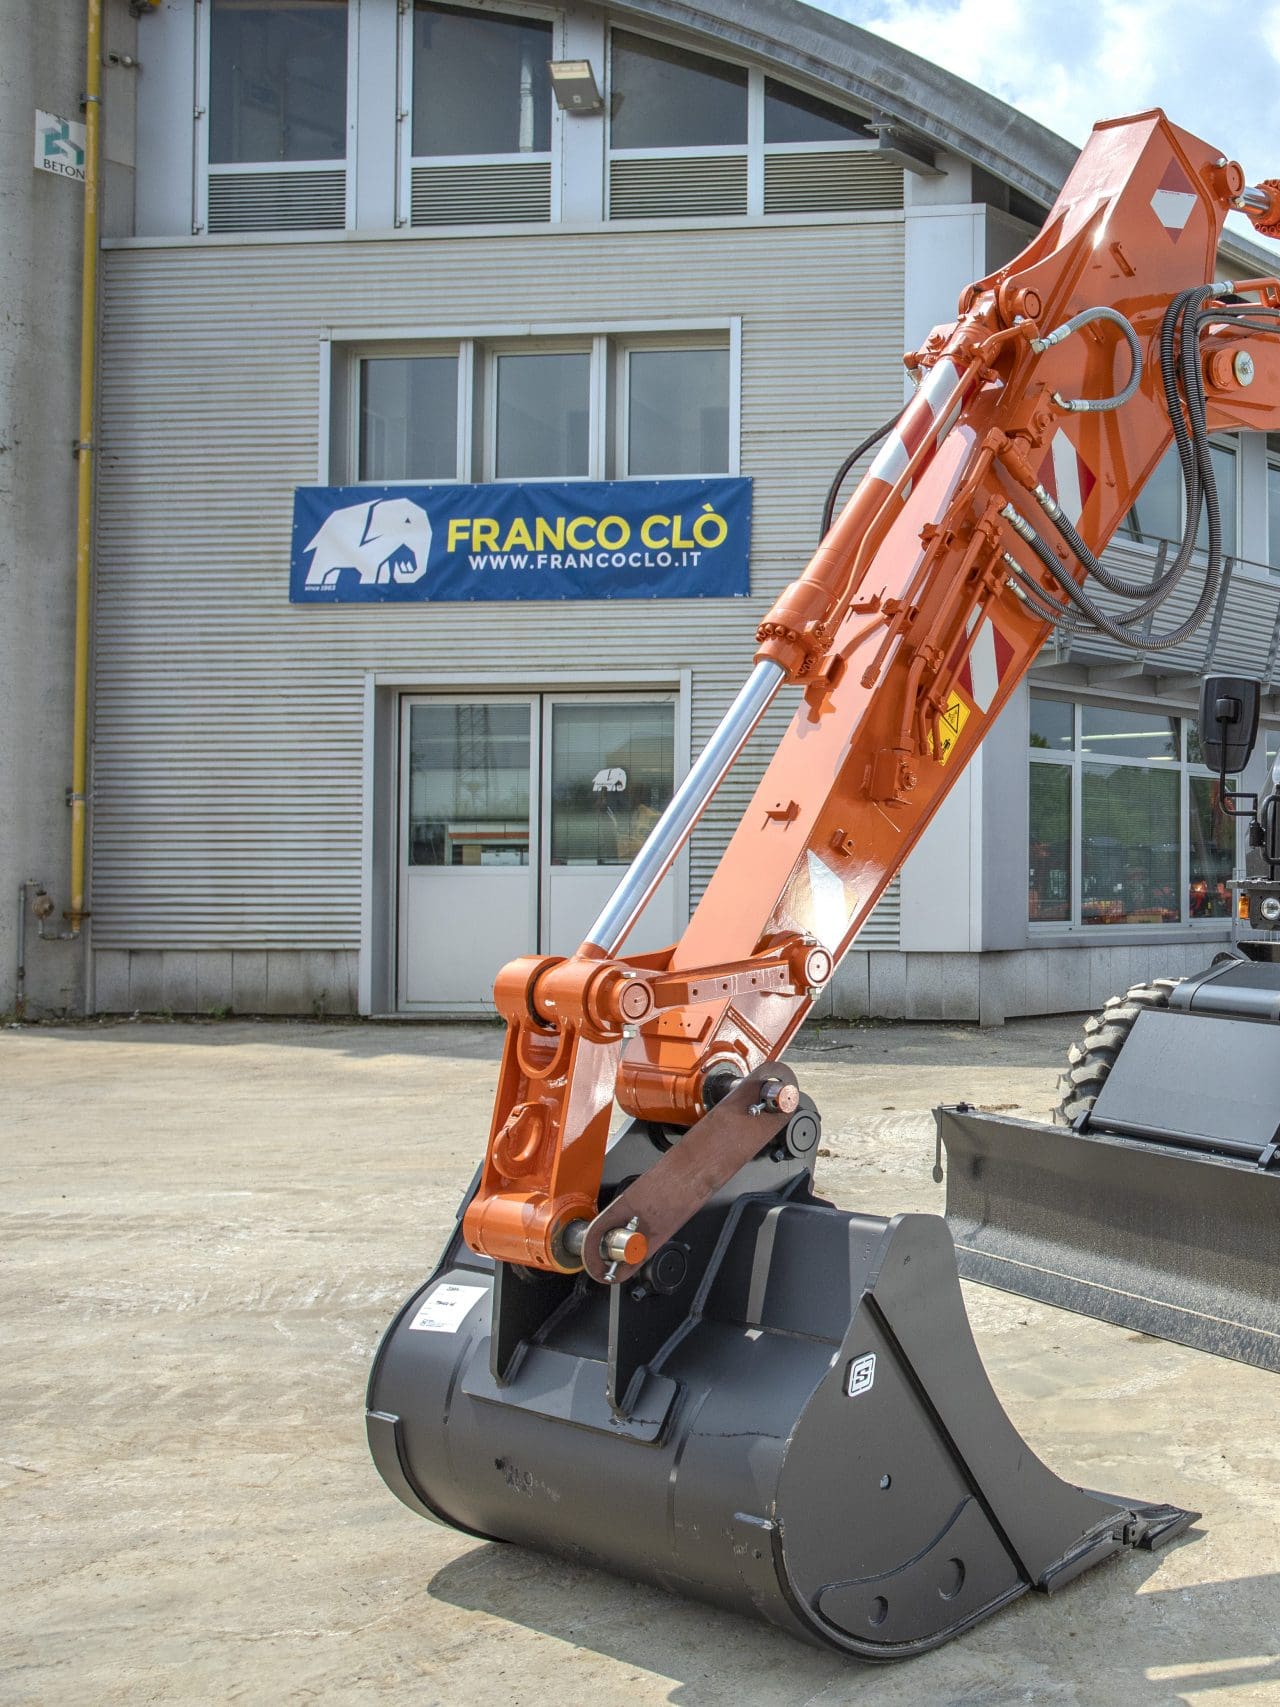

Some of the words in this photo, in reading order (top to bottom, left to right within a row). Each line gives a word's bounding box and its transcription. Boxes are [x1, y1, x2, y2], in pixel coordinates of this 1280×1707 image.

[447, 515, 632, 553] FRANCO
[640, 503, 729, 550] CLÒ
[468, 551, 702, 571] WWW.FRANCOCLO.IT
